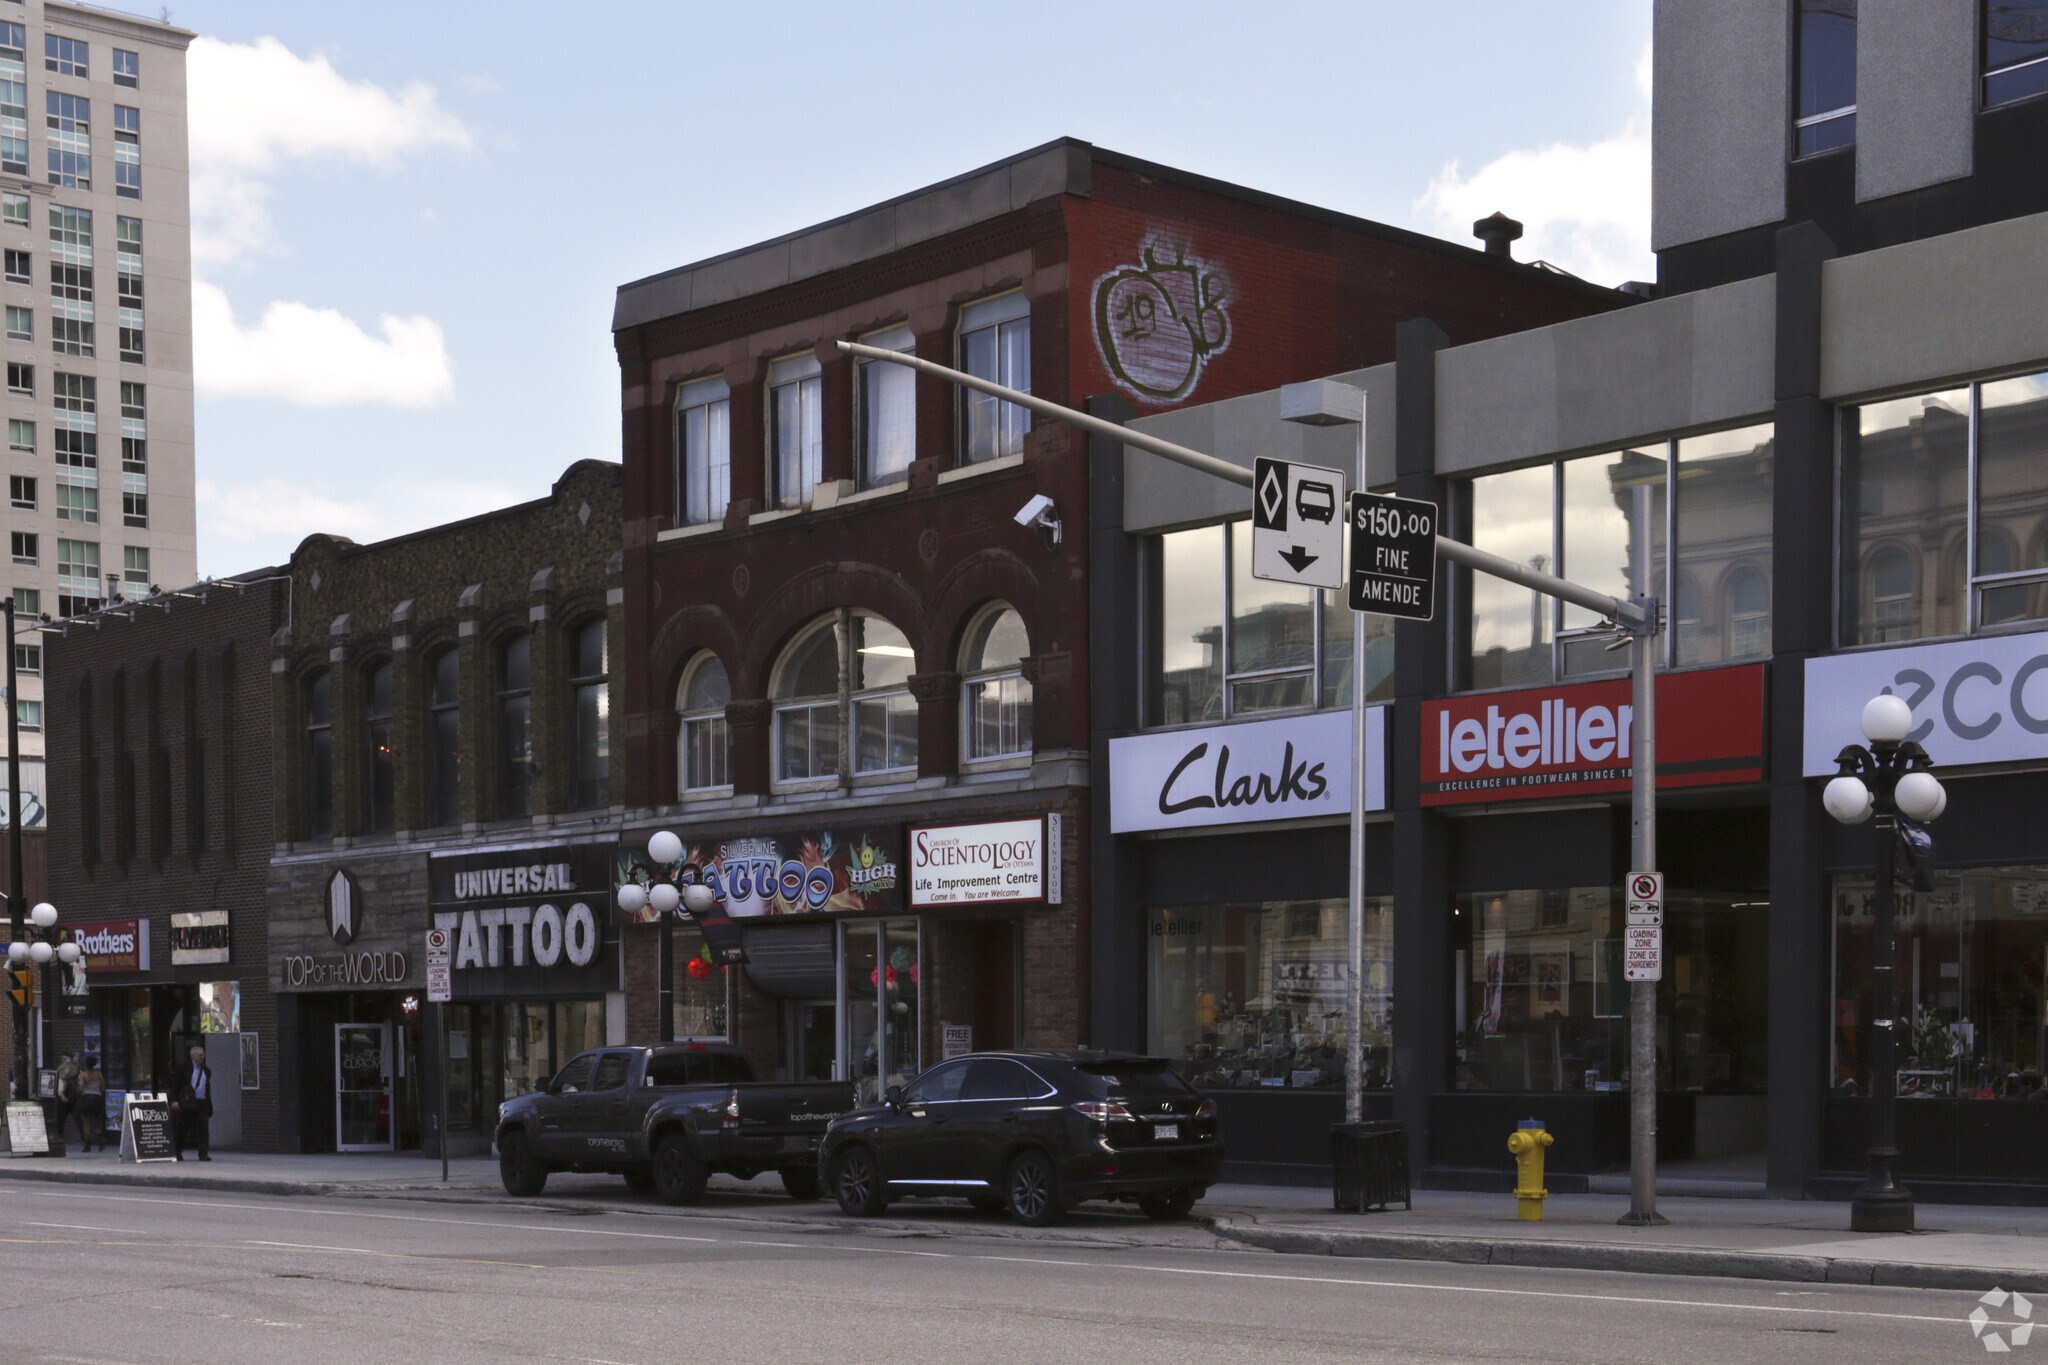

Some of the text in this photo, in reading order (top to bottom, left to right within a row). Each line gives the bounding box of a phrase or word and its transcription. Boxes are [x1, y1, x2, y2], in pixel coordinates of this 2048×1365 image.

[1356, 506, 1430, 538] $150.00
[1376, 546, 1410, 570] FINE
[1361, 579, 1421, 606] AMENDE
[1439, 698, 1633, 774] letellier
[1158, 740, 1328, 815] Clarks
[1439, 768, 1633, 792] EXCELLENCE IN FOOTWEAR SINCE 18
[719, 841, 777, 860] SILVERLINE
[916, 831, 1036, 870] SCIENTOLOGY
[454, 863, 576, 899] UNIVERSAL
[850, 863, 897, 884] HIGH
[872, 879, 896, 889] WAYS
[915, 873, 1038, 891] Life Improvement Centre
[930, 888, 1022, 902] Come in. You are Welcome.
[74, 927, 135, 954] Brothers
[434, 902, 600, 969] TATTOO
[1629, 930, 1657, 939] LOADING
[1634, 939, 1652, 947] ZONE
[1628, 960, 1658, 969] CHARGEMENT
[1629, 951, 1658, 960] ZONE DE
[285, 951, 406, 986] TOP OF THE WORLD
[946, 1029, 969, 1039] FREE
